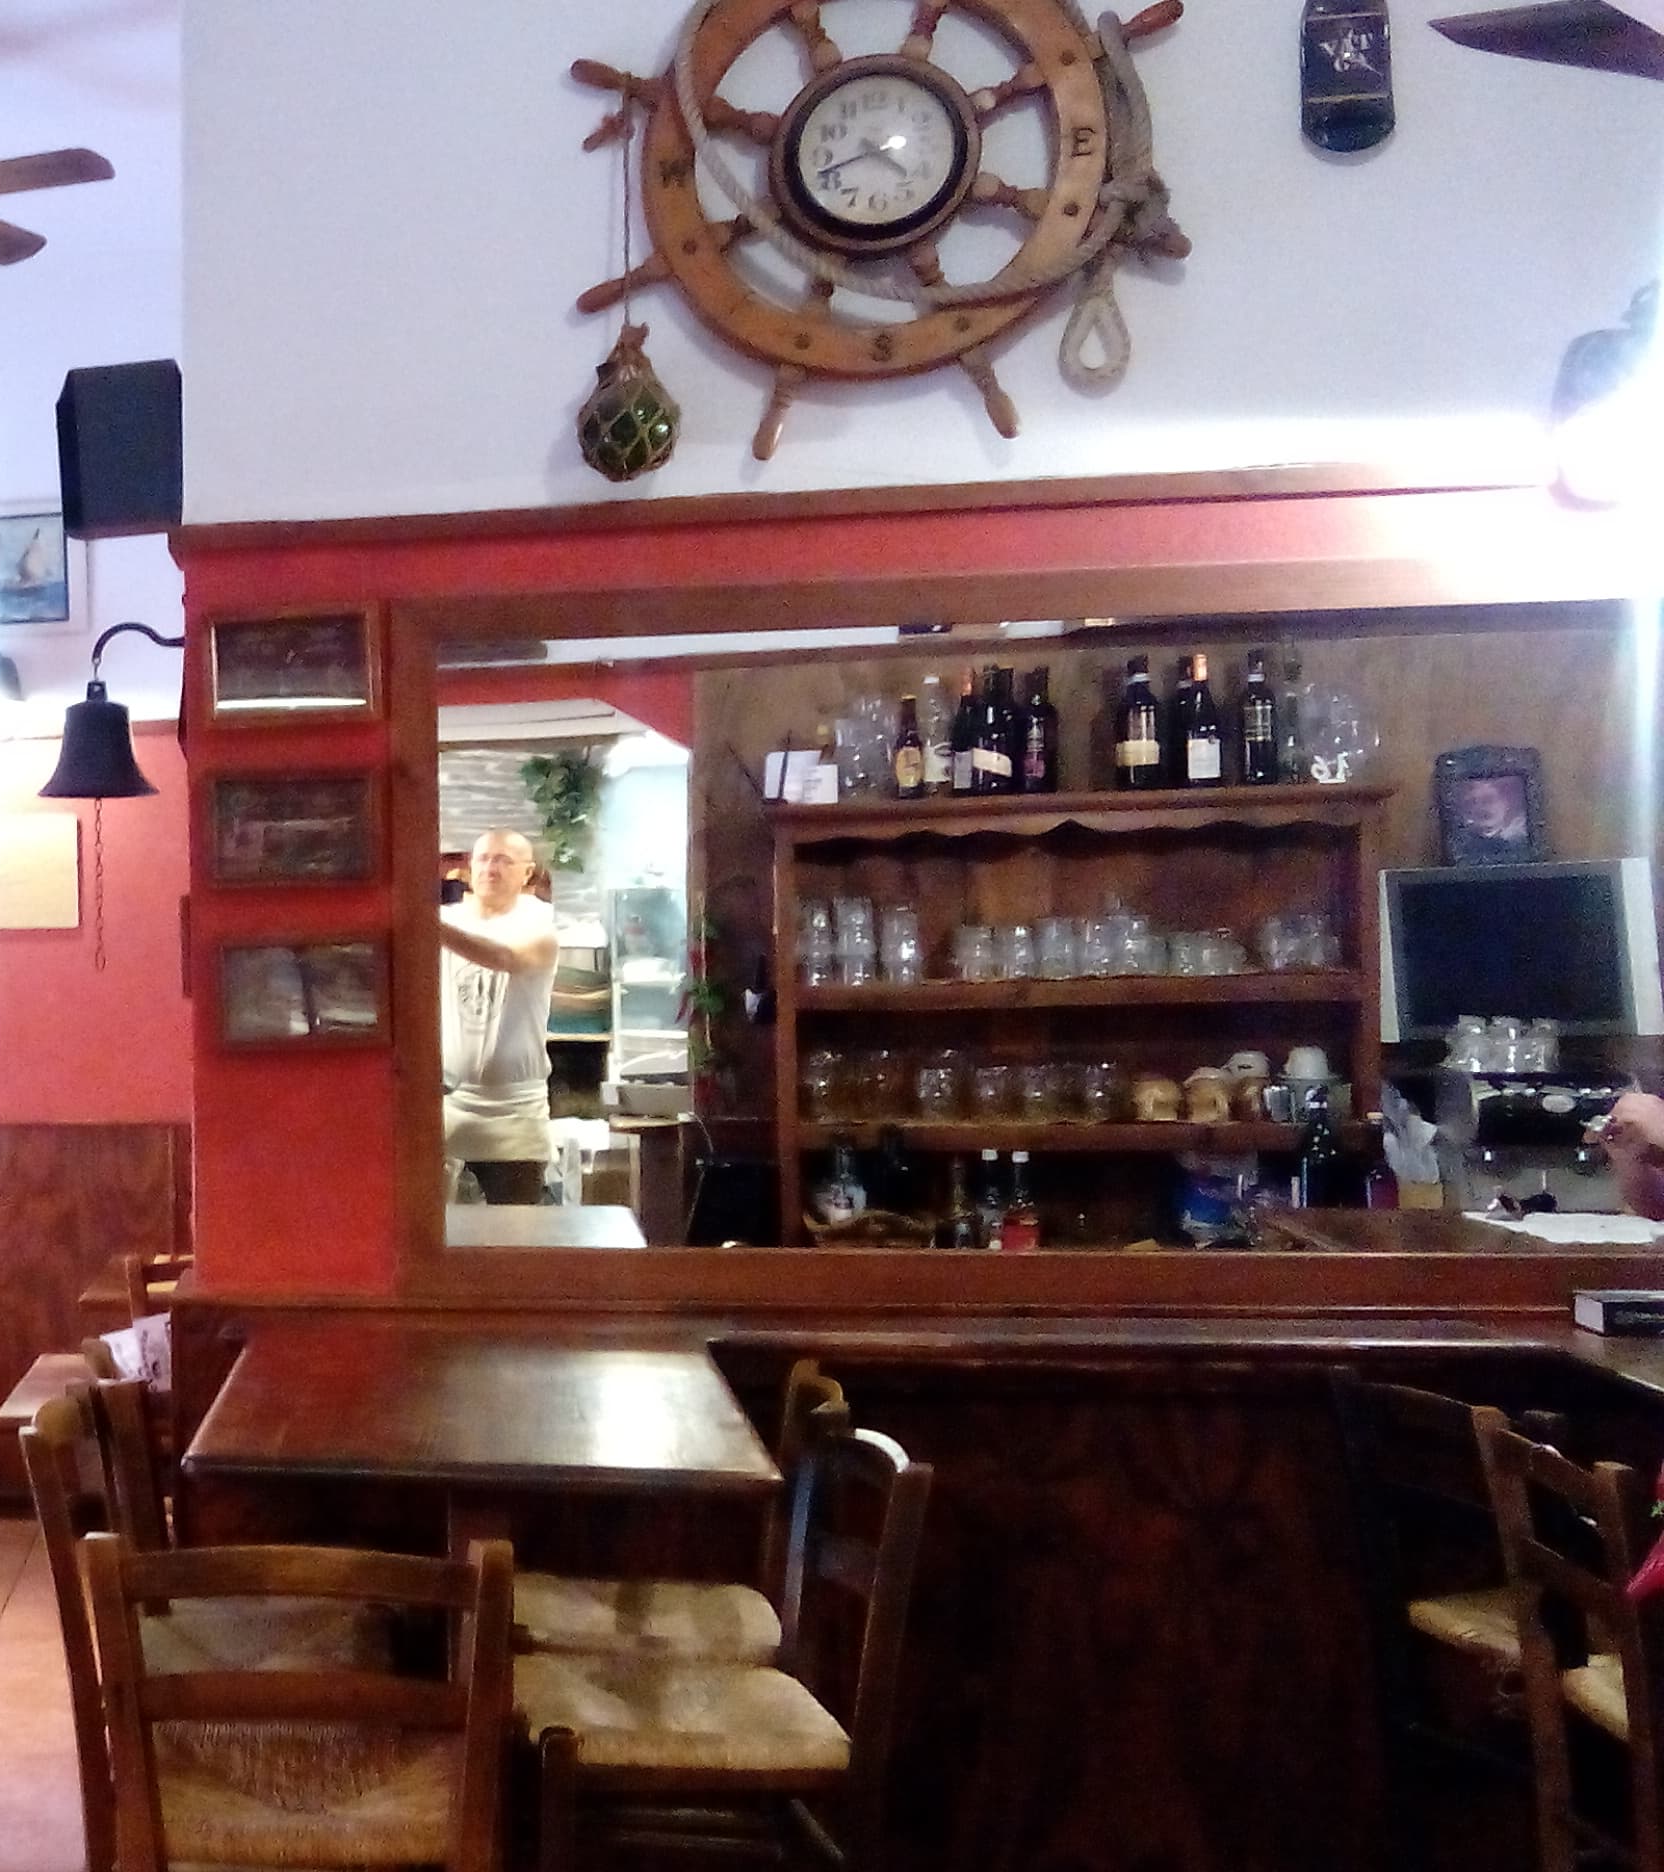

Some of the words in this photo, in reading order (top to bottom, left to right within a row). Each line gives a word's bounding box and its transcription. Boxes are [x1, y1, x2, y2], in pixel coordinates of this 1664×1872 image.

[820, 124, 847, 142] 10
[1071, 126, 1096, 158] E
[820, 170, 842, 190] 8
[841, 187, 859, 208] 7
[868, 193, 888, 212] 6
